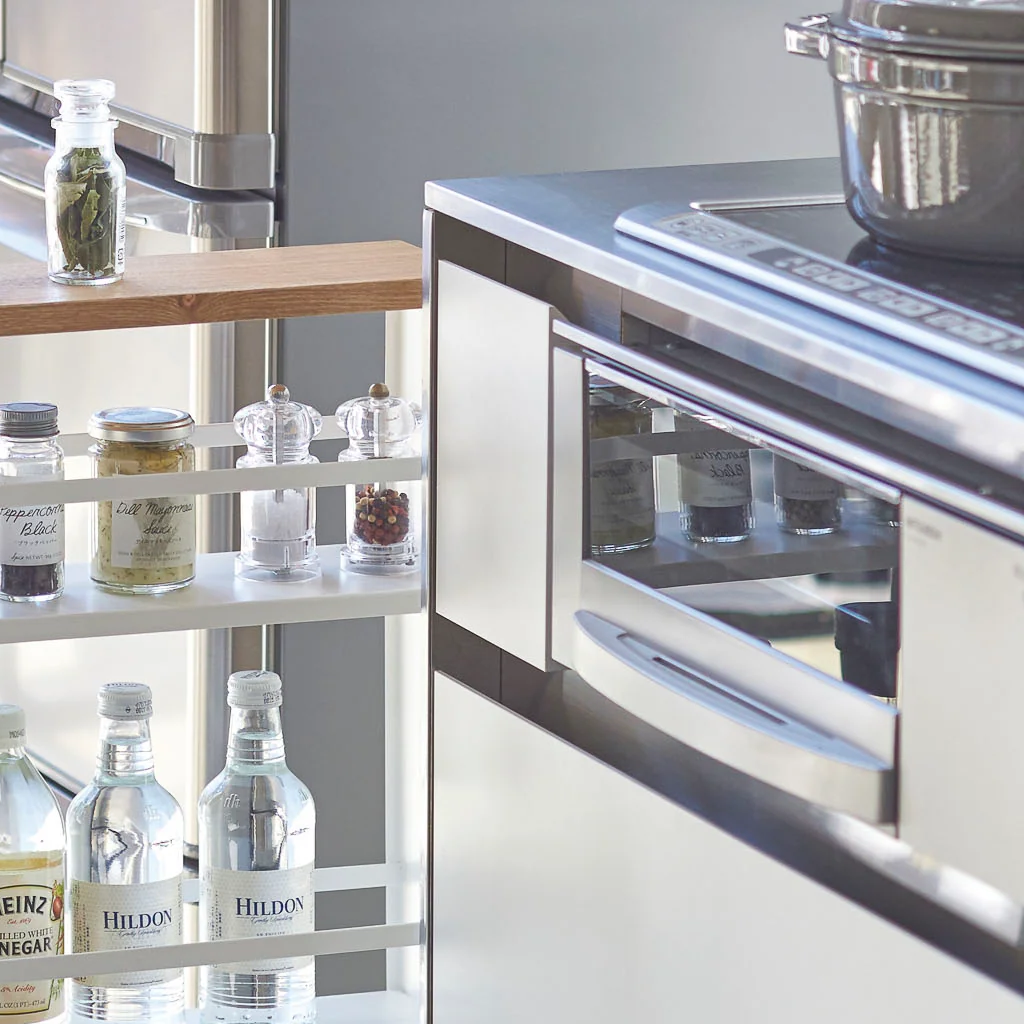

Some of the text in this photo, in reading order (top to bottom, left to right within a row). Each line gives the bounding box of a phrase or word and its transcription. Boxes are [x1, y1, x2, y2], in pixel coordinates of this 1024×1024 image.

[116, 502, 142, 516] Dill
[20, 519, 57, 537] Black
[235, 895, 304, 916] HILDON
[103, 908, 172, 930] HILDON
[28, 927, 53, 938] WHITE
